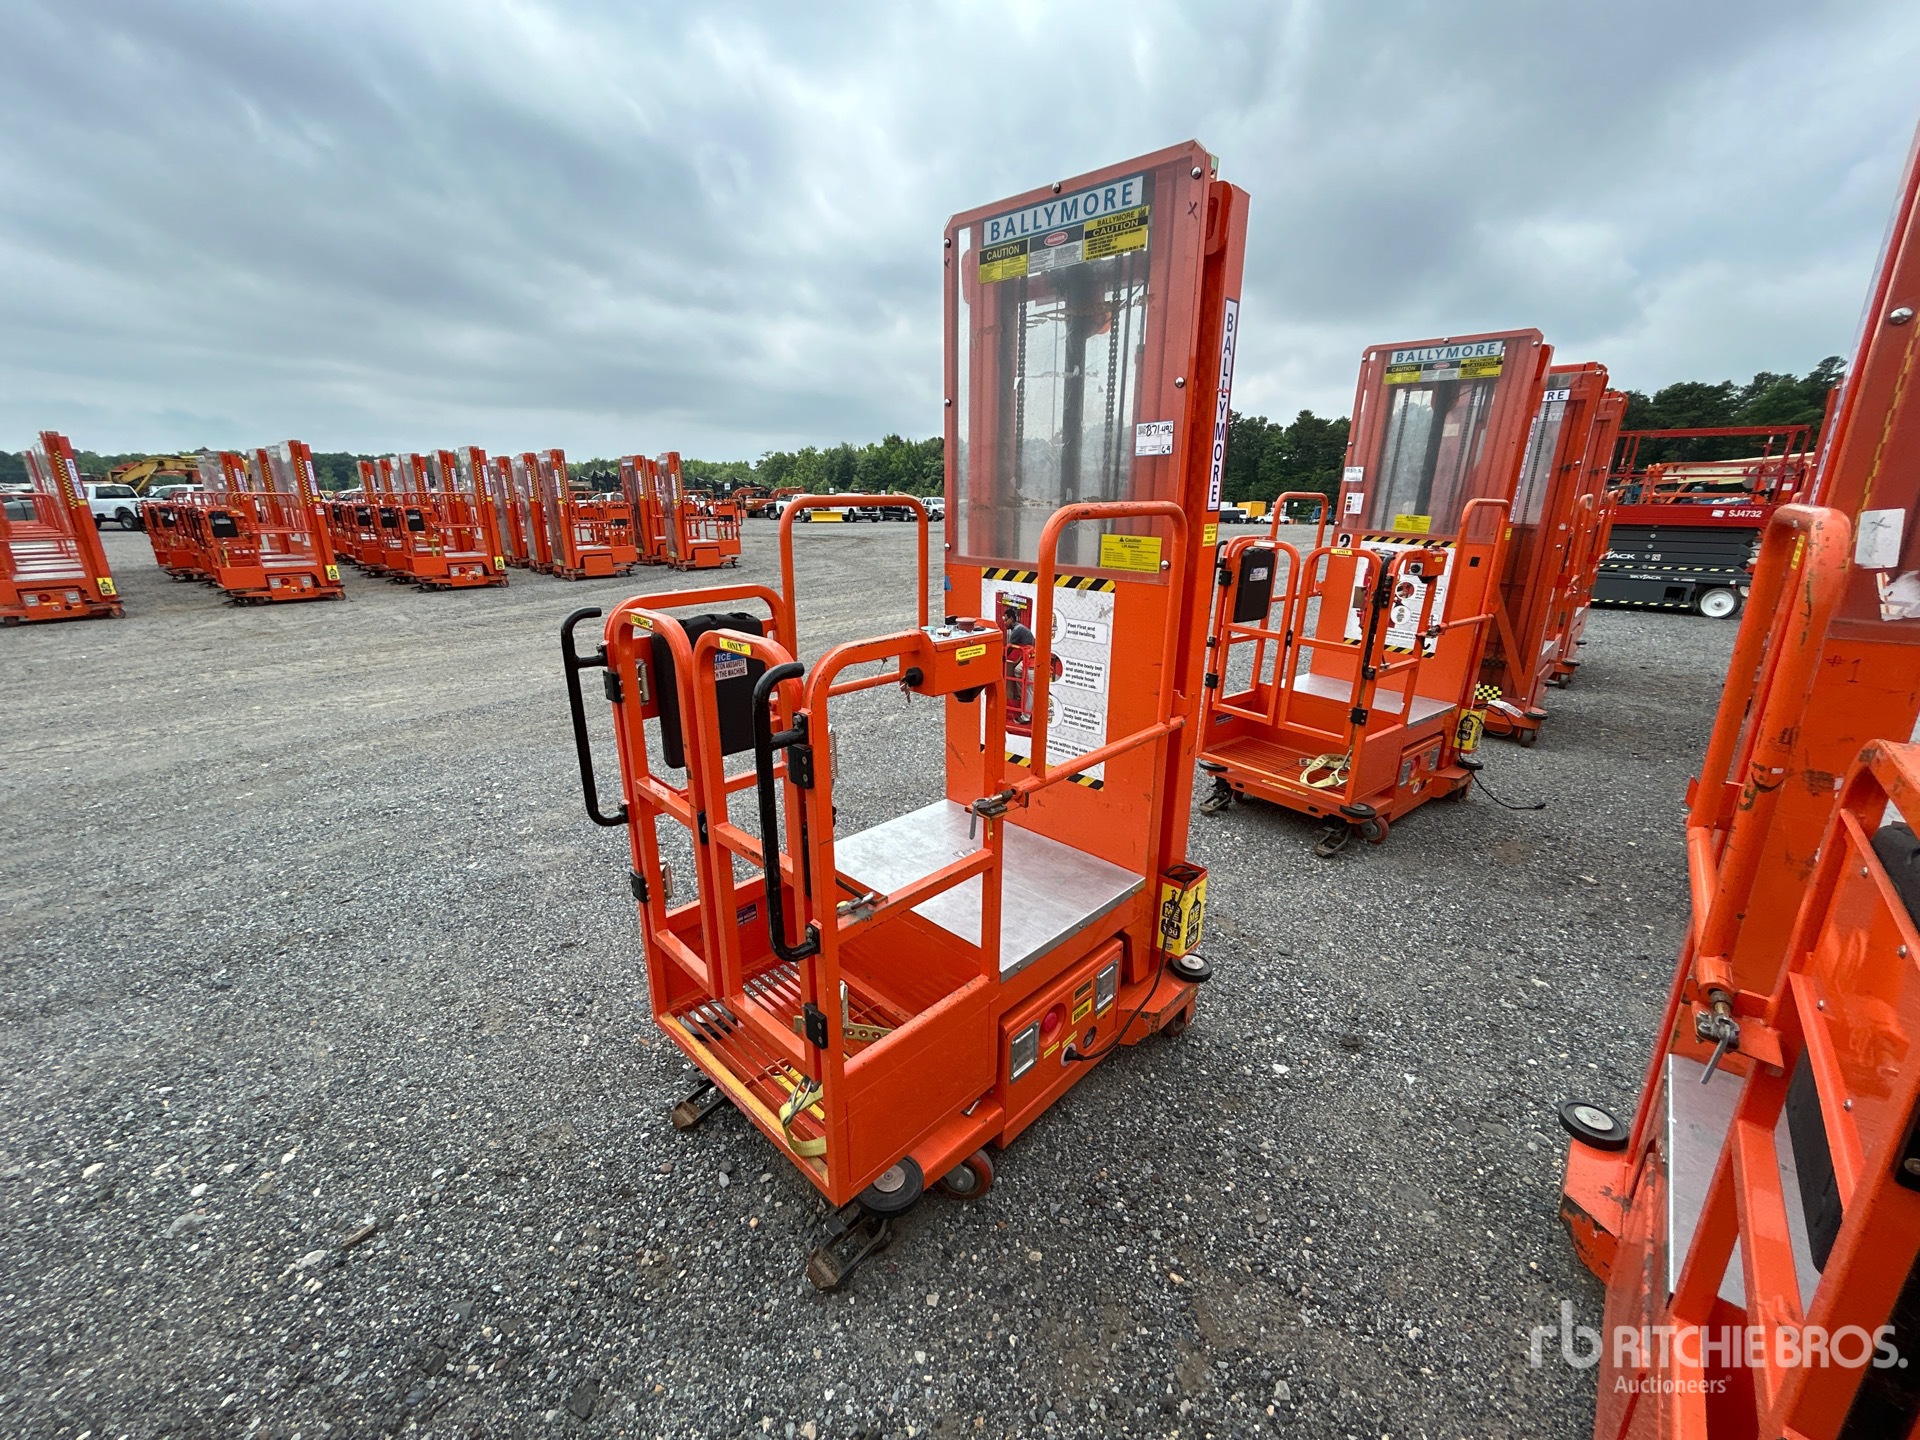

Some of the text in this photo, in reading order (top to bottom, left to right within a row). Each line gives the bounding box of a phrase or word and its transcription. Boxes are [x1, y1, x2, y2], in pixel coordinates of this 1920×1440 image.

[990, 181, 1134, 242] BALLYMORE
[1097, 210, 1135, 227] BALLYMORE
[1092, 219, 1139, 237] CAUTION
[986, 244, 1020, 261] CAUTION
[1396, 342, 1497, 363] BALLYMORE
[1391, 365, 1417, 373] CAUTION
[1210, 312, 1234, 503] BALLYMORE
[1728, 509, 1763, 518] SJ4732
[1077, 623, 1087, 631] First
[715, 652, 731, 663] TICE
[1084, 662, 1094, 670] body
[1083, 717, 1100, 725] attached
